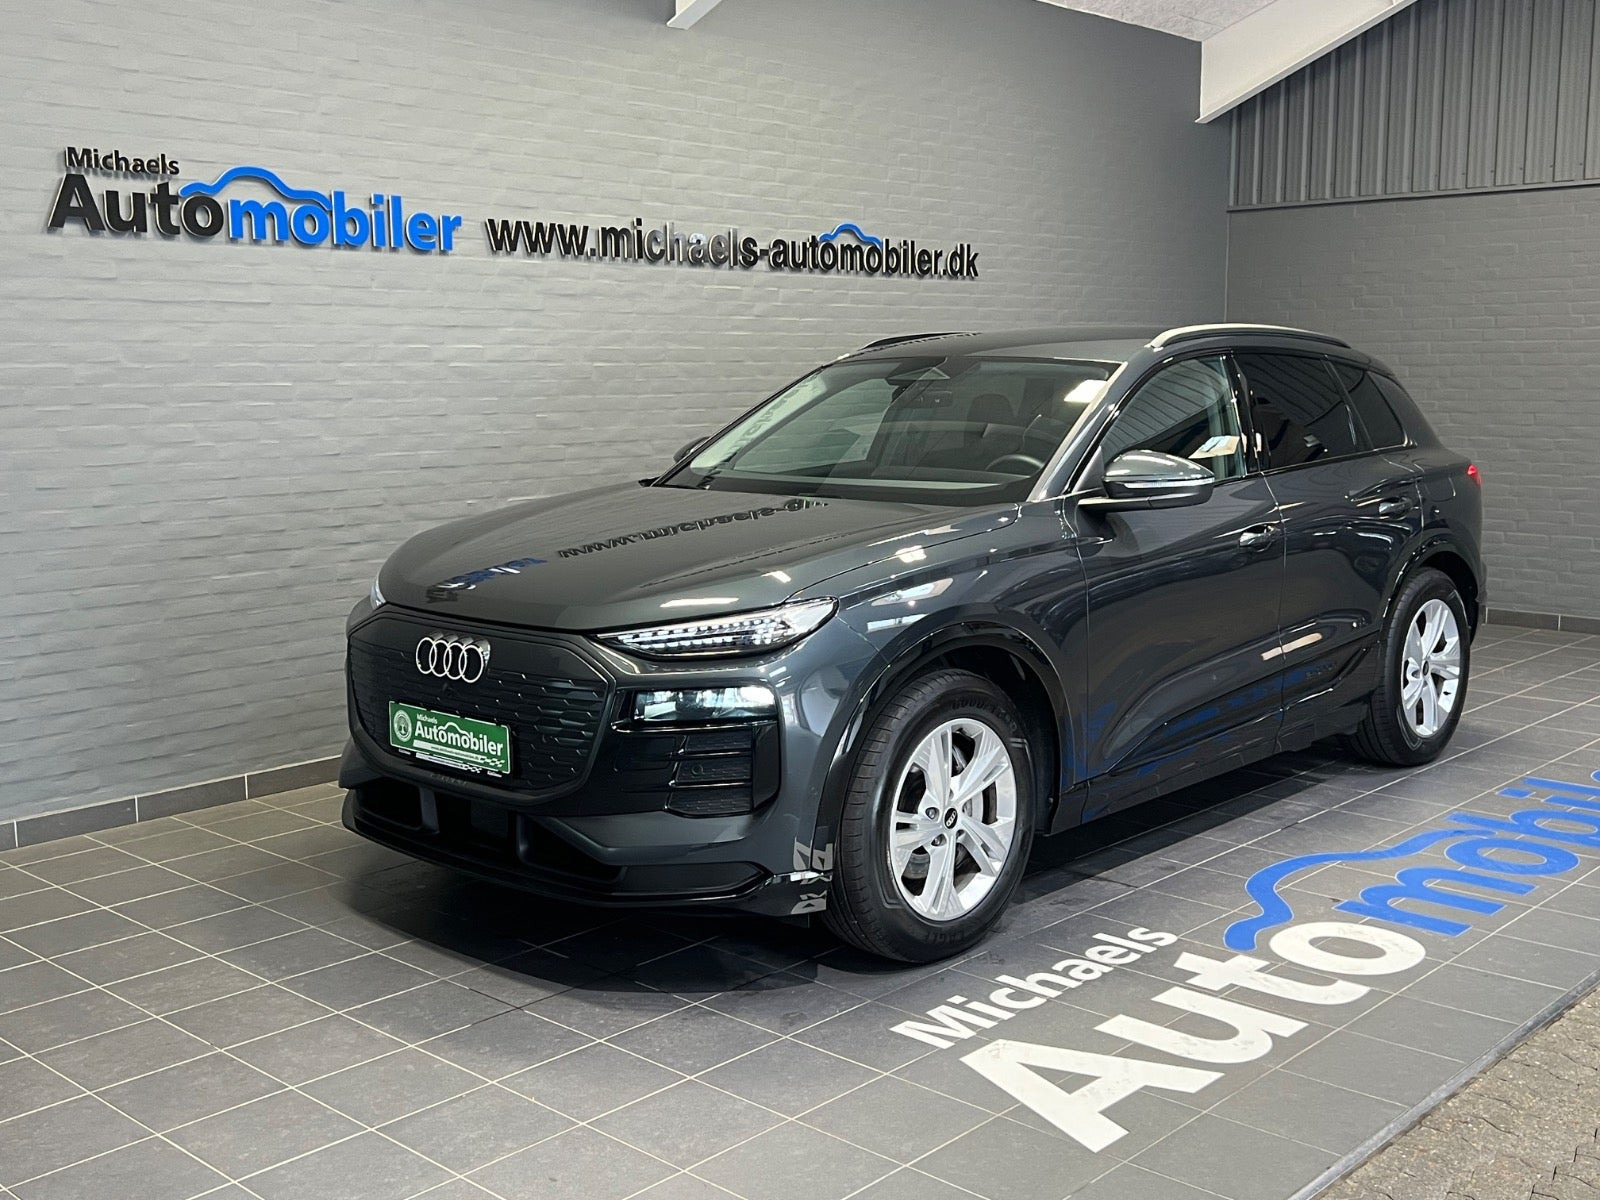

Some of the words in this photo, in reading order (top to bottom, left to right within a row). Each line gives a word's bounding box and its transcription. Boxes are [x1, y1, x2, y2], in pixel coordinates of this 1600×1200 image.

[64, 147, 180, 175] Michaels
[48, 173, 462, 251] Automobiler
[485, 216, 980, 278] www.michaels-automobiler.dk
[415, 721, 503, 756] Automobiler
[890, 924, 1177, 1049] Michaels
[960, 766, 1600, 1153] Automobil
